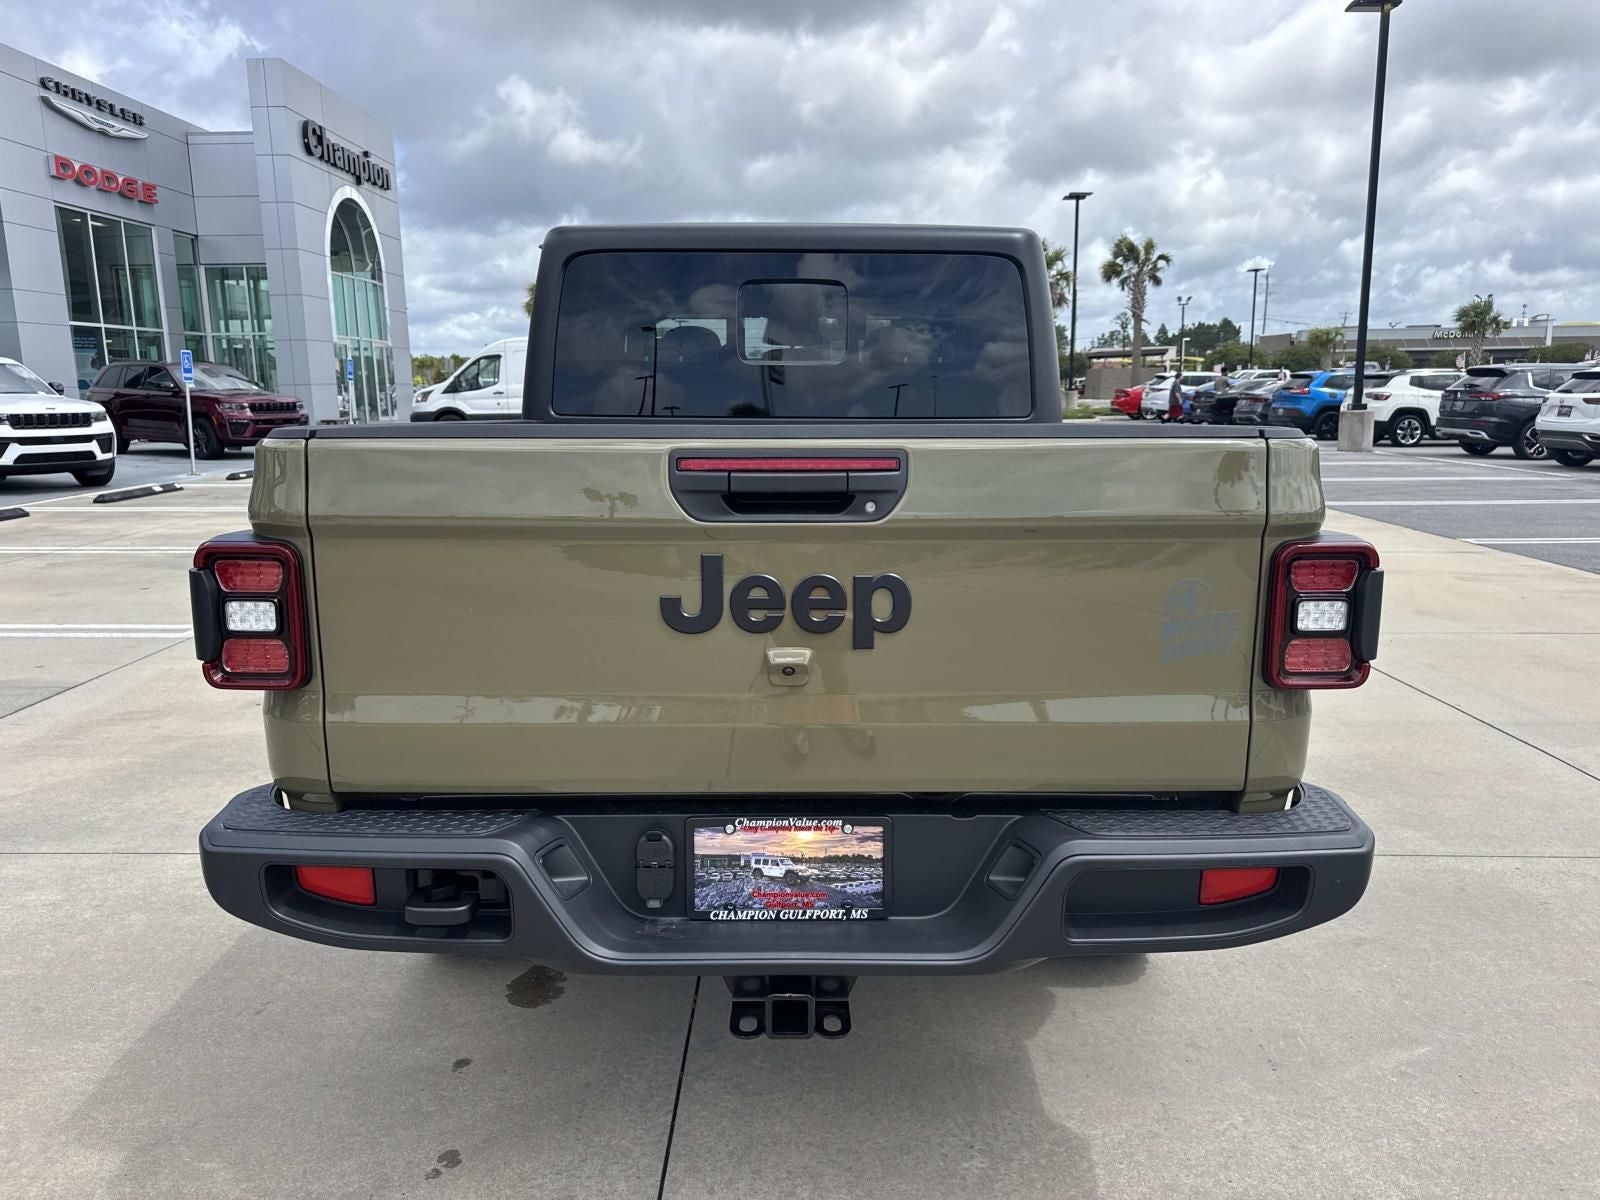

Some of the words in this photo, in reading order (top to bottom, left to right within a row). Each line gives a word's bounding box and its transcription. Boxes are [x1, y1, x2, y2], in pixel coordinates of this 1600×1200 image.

[40, 76, 146, 126] CHRYSLER
[48, 153, 159, 205] DODGE
[302, 119, 392, 191] Champion
[659, 553, 912, 650] Jeep
[734, 817, 843, 828] ChampionValue.com
[709, 910, 776, 920] CHAMPION
[780, 909, 847, 921] GULFPORT,
[850, 909, 869, 919] MS
